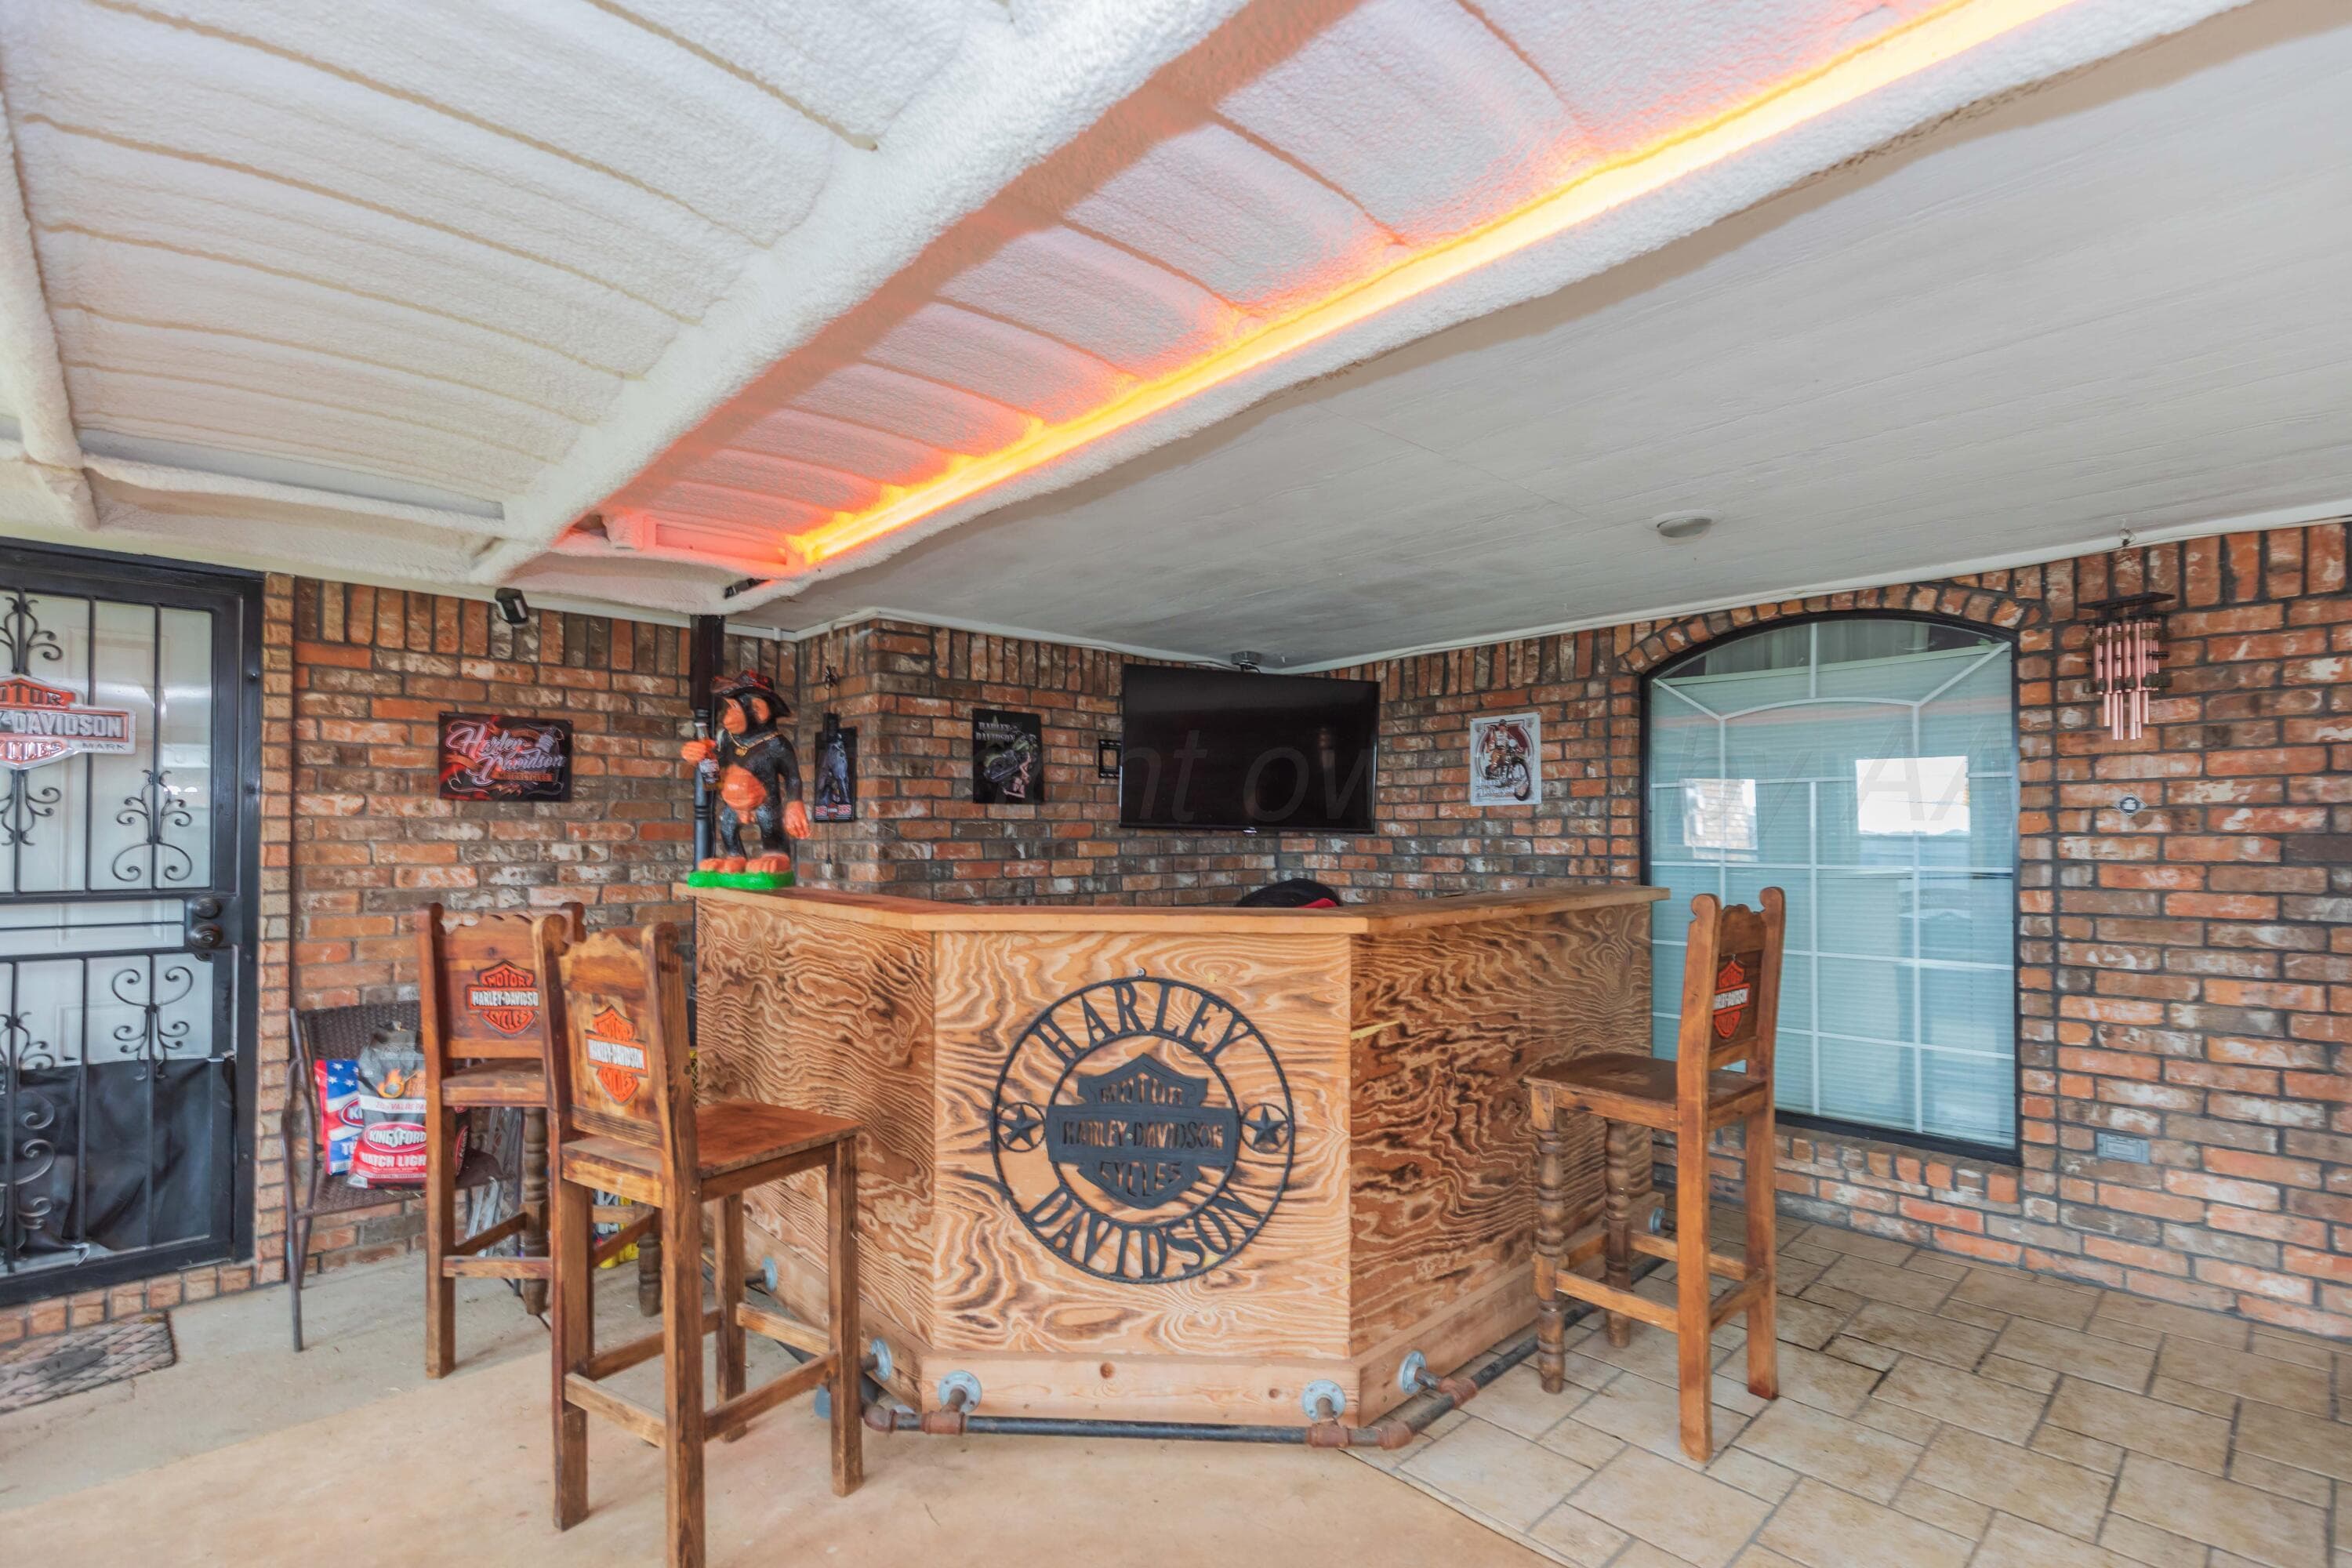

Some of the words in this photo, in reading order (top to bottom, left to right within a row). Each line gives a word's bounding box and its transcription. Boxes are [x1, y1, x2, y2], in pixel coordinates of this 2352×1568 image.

[0, 710, 122, 738] -DAVIDSON
[82, 742, 126, 750] MARK
[445, 723, 526, 761] Harley
[466, 747, 566, 786] Davidson
[486, 969, 526, 987] MOTOR
[472, 990, 540, 1007] HARLEY-DAVIDSO
[1031, 982, 1256, 1067] HARLEY
[1100, 1073, 1183, 1105] MOTOR
[397, 1154, 426, 1167] LIGH
[1100, 1160, 1182, 1197] CYCLES
[1024, 1183, 1265, 1279] DAVIDSON
